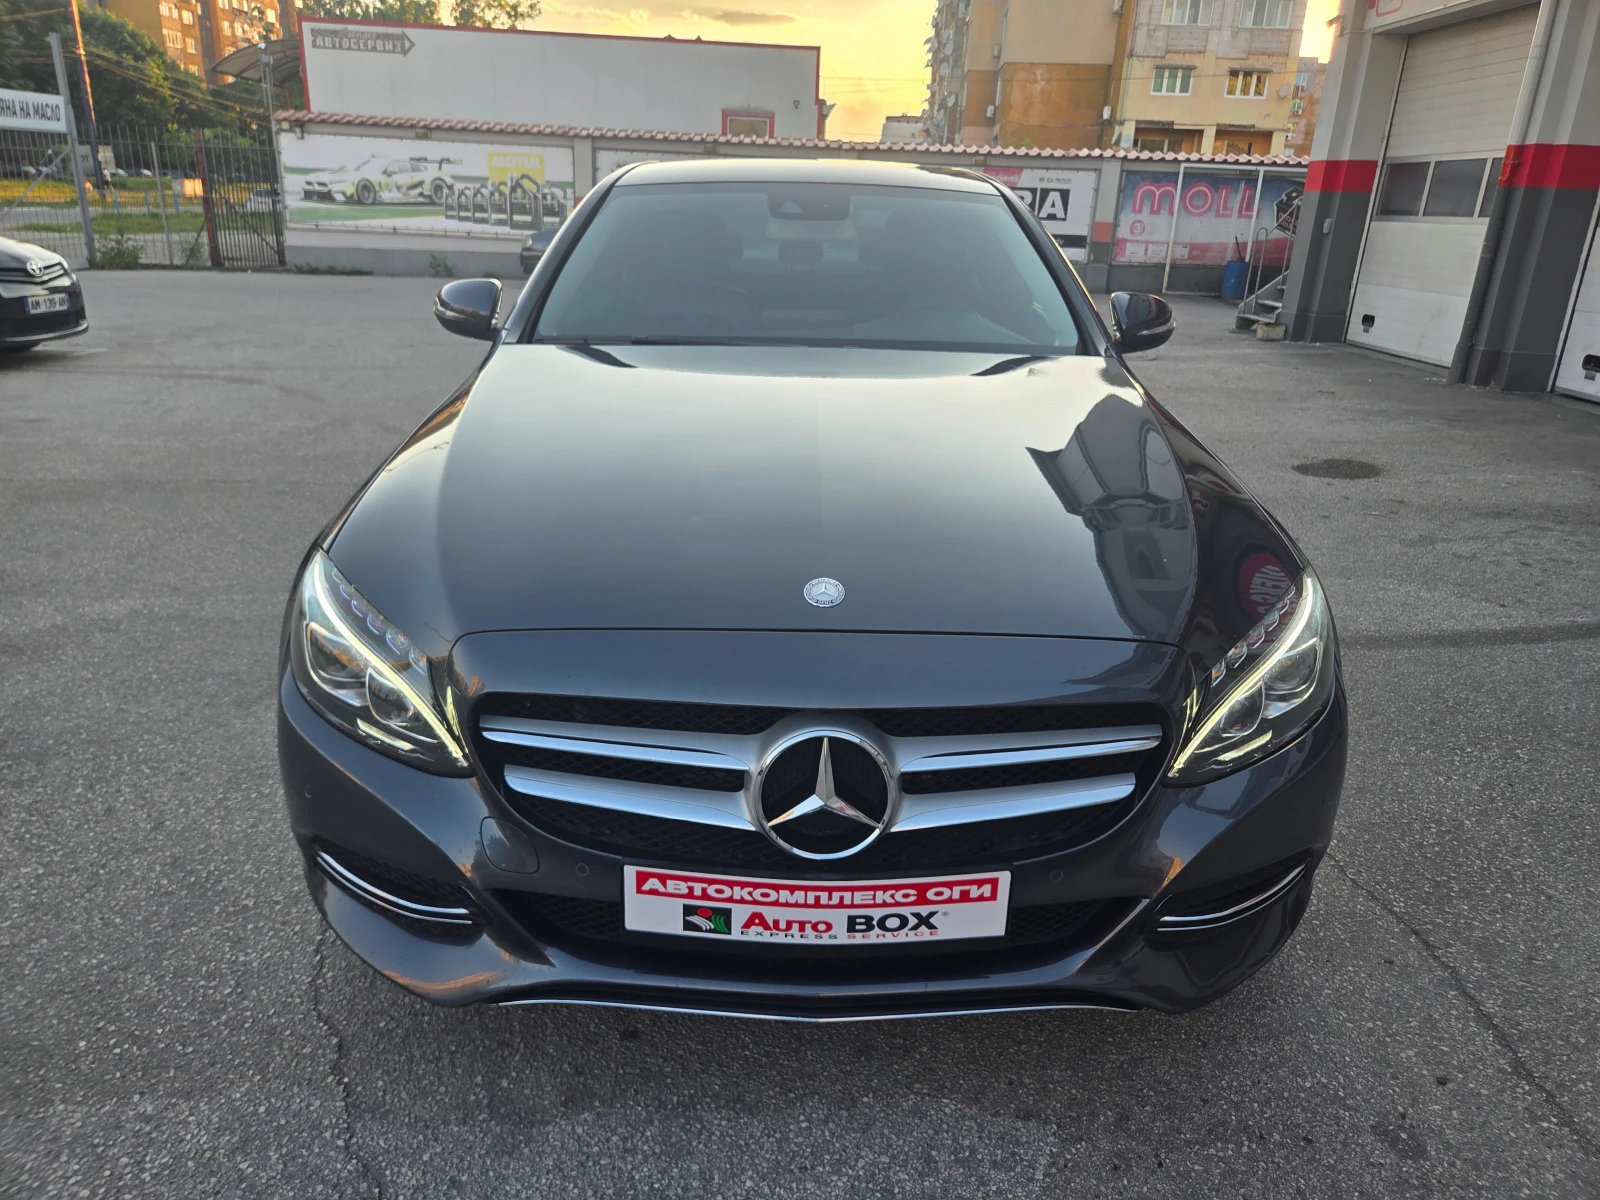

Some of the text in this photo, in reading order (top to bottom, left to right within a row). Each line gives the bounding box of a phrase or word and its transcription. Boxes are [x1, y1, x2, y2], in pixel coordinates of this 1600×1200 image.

[316, 35, 403, 52] АВТОСЕРВИЗ
[18, 99, 32, 119] НА
[32, 101, 61, 122] МАСЛО
[490, 154, 542, 170] MOTUL
[641, 877, 992, 905] АВТОКОМПЛЕКС ОГИ
[740, 930, 939, 940] EXPRESS SERVICE
